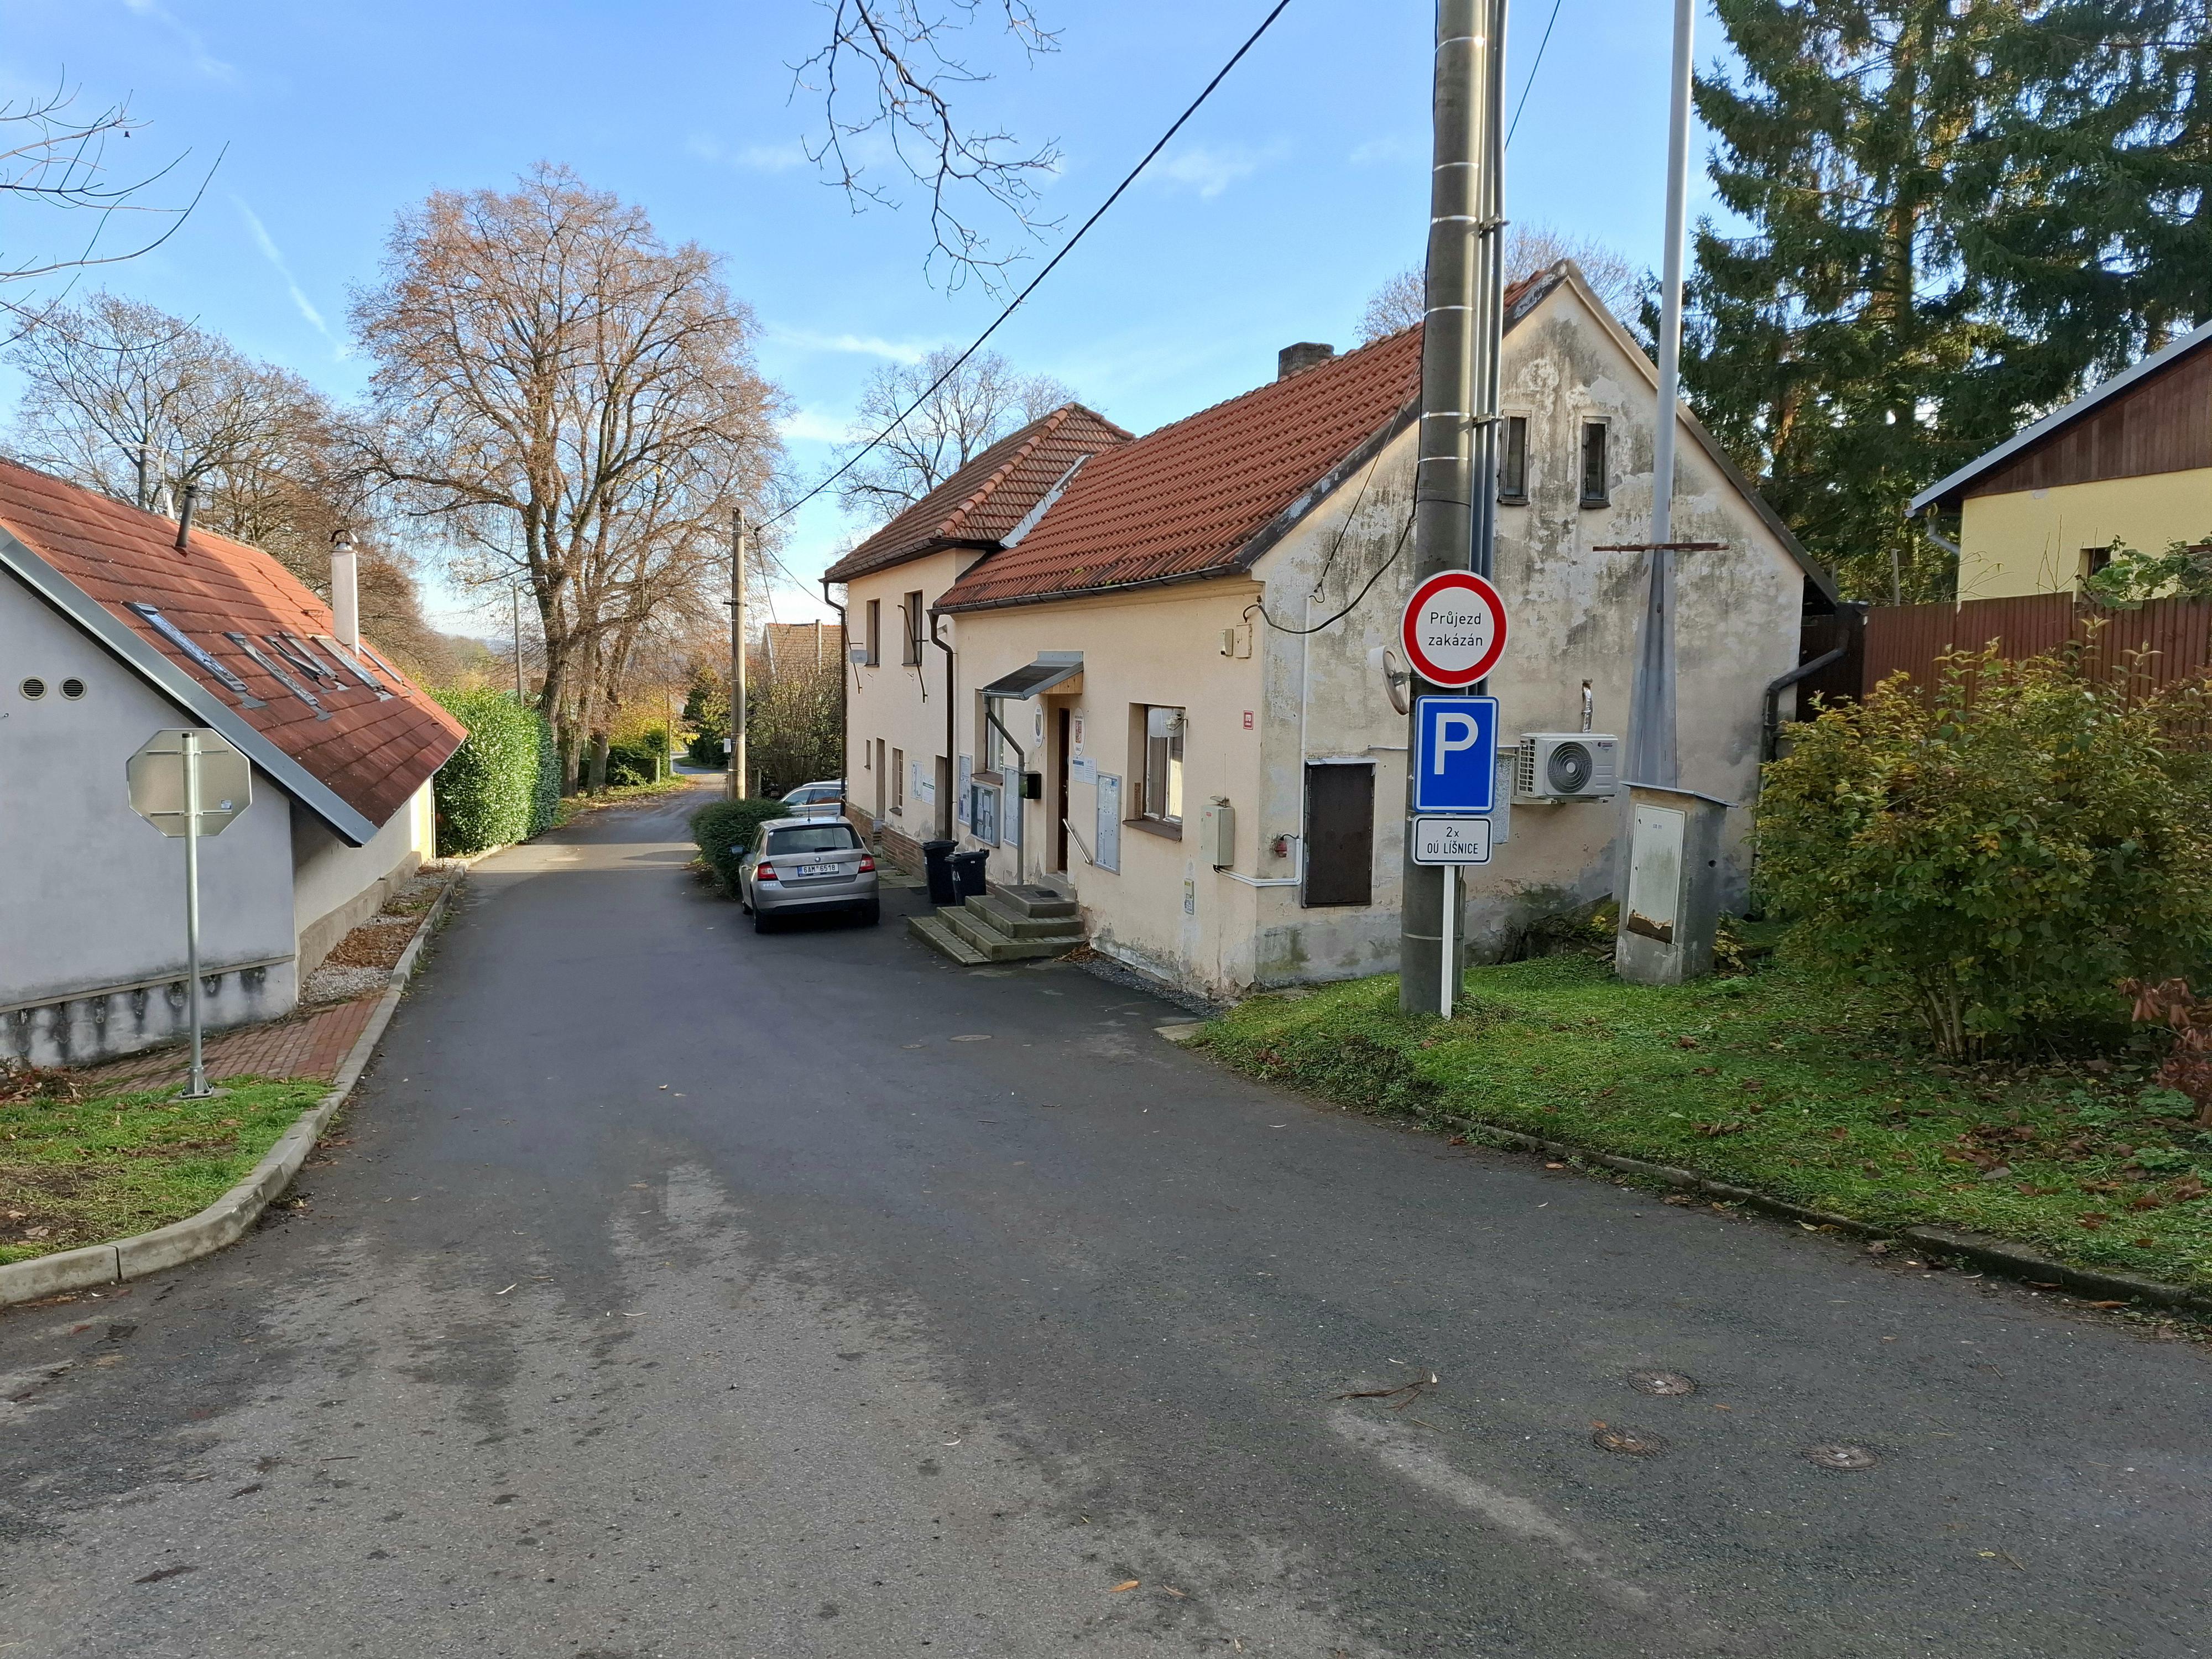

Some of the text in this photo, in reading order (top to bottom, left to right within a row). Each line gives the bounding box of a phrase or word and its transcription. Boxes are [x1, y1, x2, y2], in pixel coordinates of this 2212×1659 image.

[1430, 611, 1481, 628] Průjezd
[1428, 633, 1483, 646] zakázán
[1434, 713, 1479, 775] P
[1427, 839, 1478, 854] OÚ LÍŠNICE
